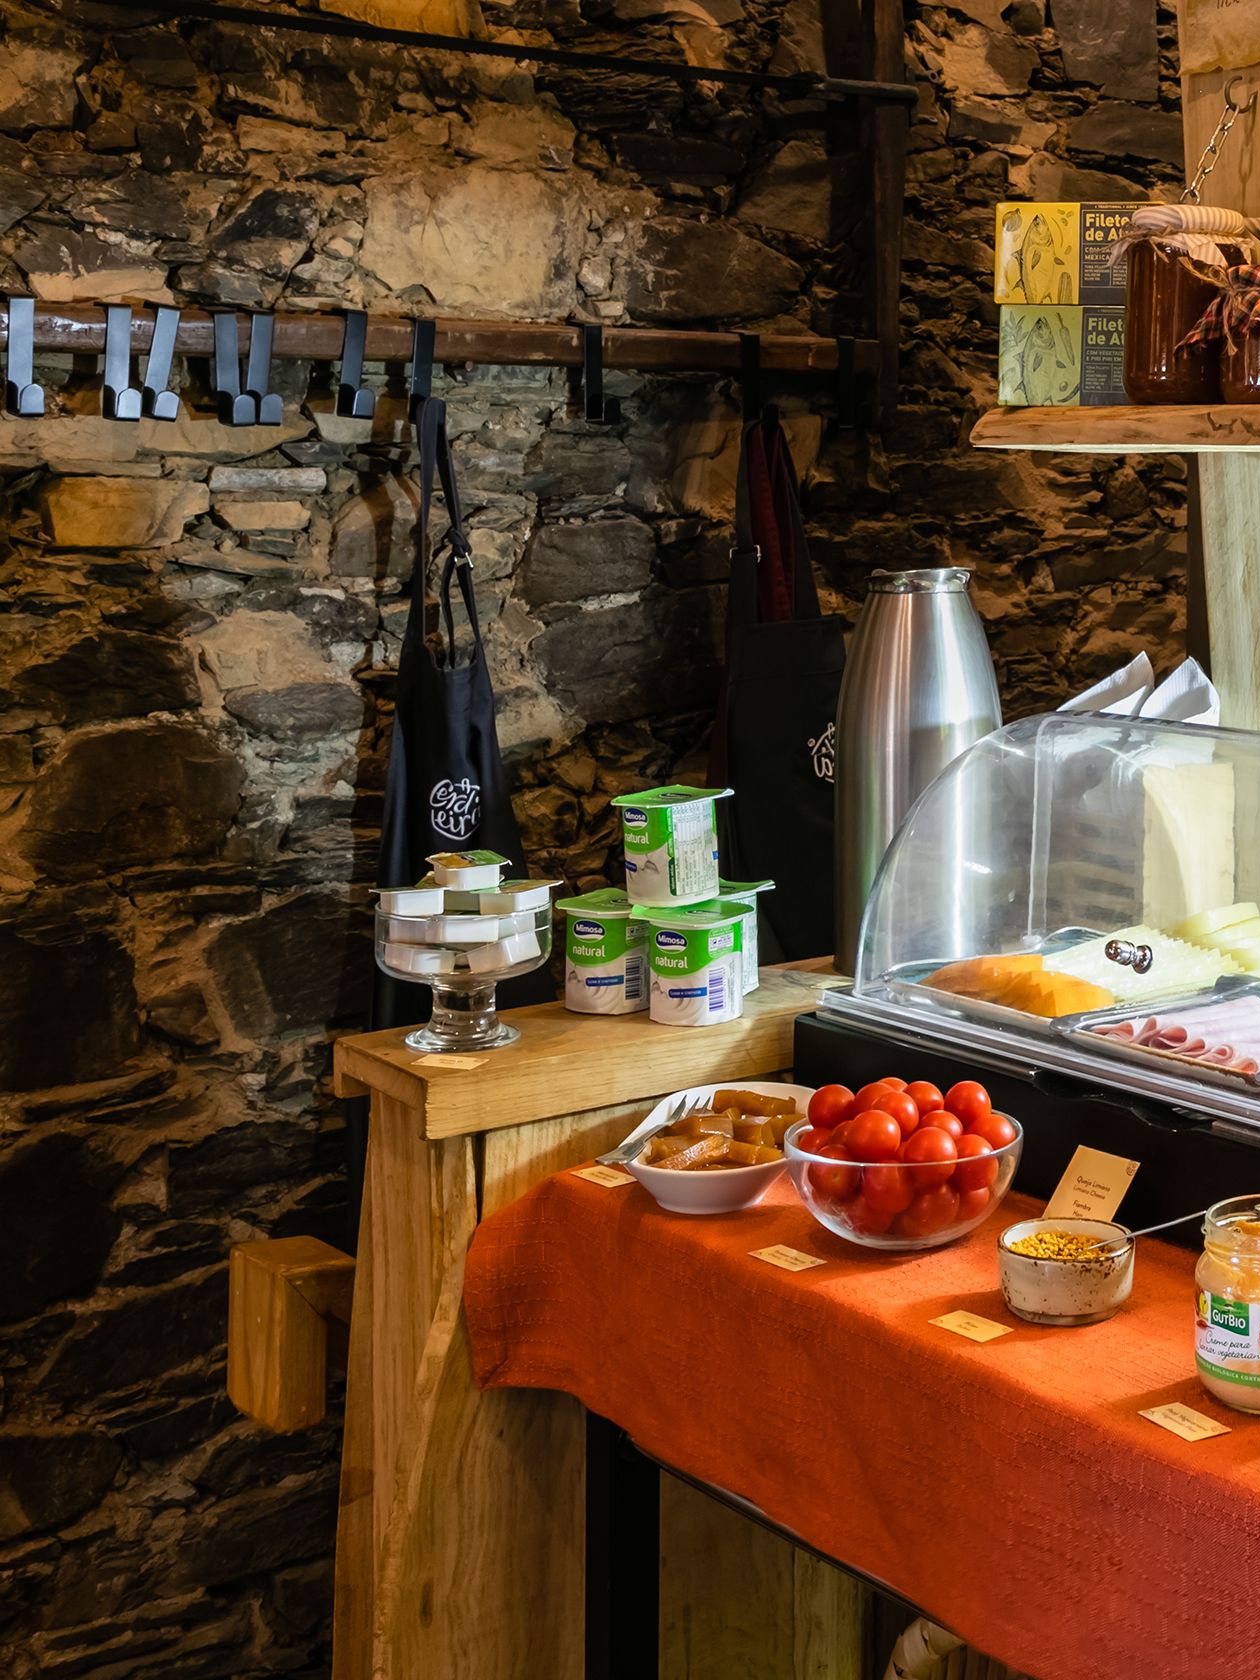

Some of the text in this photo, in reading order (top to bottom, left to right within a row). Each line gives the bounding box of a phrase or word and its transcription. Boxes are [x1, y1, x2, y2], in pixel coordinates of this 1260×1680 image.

[1086, 213, 1131, 227] Filete
[1085, 228, 1104, 241] de
[1088, 318, 1124, 331] Filet
[1087, 332, 1106, 344] de
[625, 812, 646, 821] Mimosa
[625, 832, 650, 844] natural
[576, 923, 602, 933] Mimosa
[658, 934, 685, 945] Mimosa
[572, 945, 606, 957] natural
[655, 956, 688, 968] natural
[1206, 1330, 1251, 1352] Creme para
